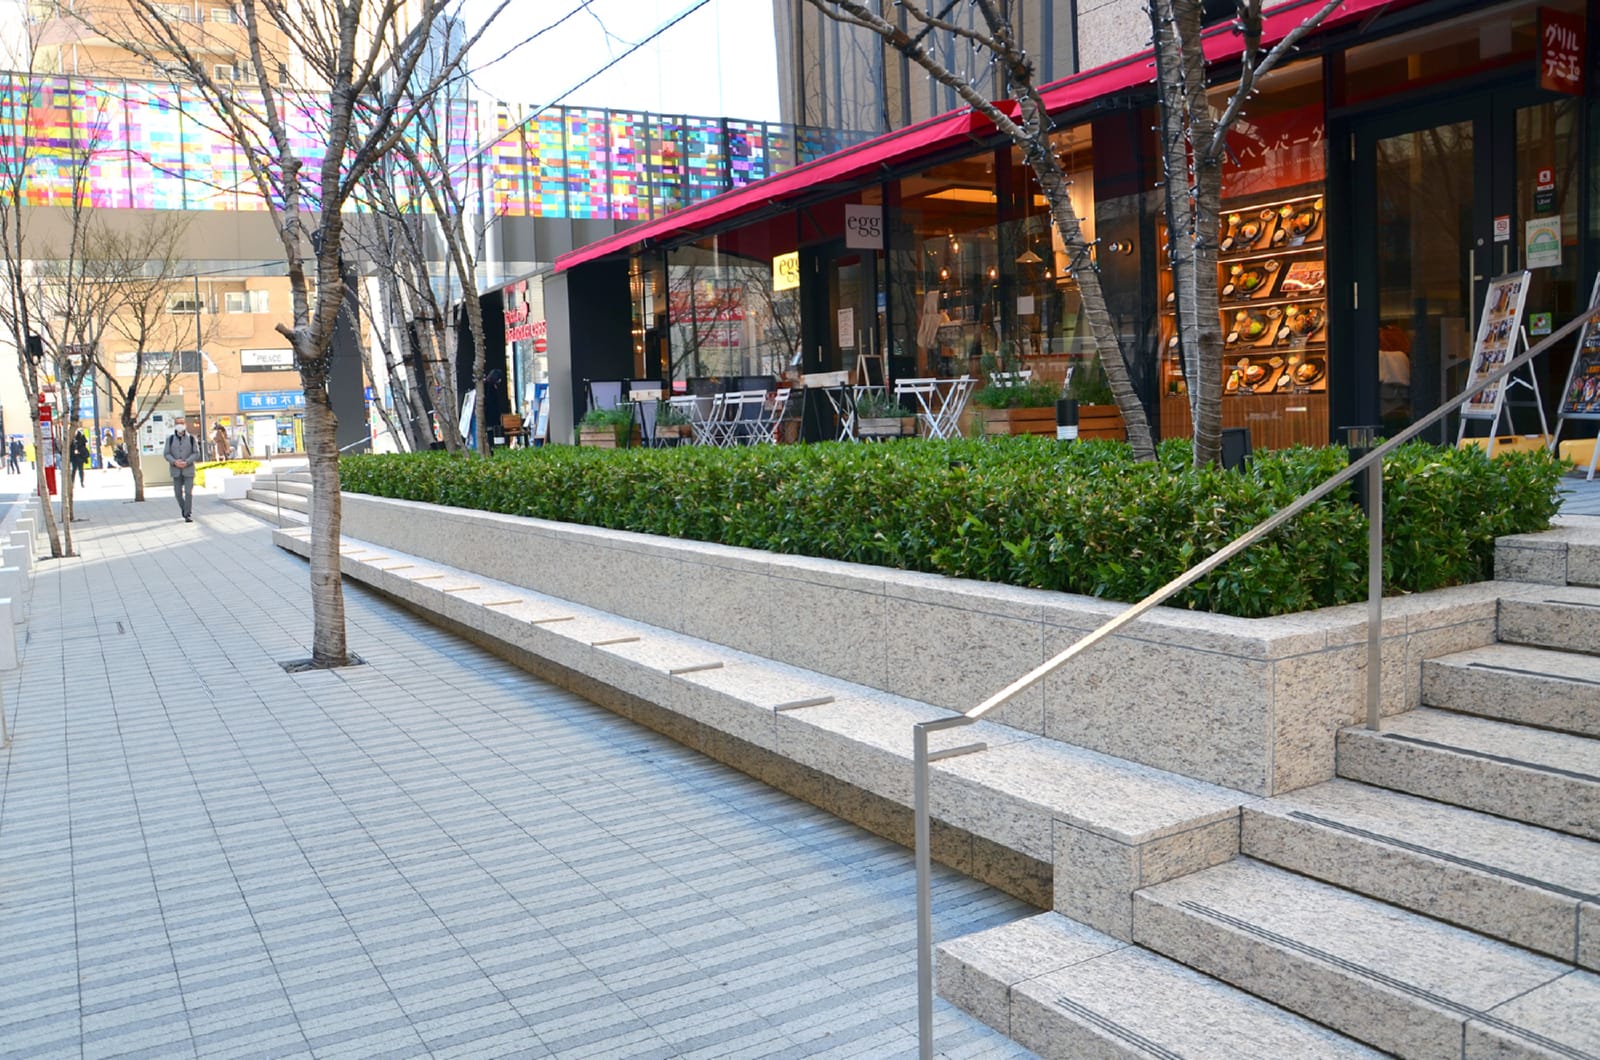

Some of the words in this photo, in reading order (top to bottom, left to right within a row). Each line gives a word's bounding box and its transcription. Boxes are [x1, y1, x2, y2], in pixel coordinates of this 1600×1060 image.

[1545, 24, 1580, 51] グリル
[1545, 50, 1581, 81] デミ玉
[847, 216, 881, 237] egg
[779, 258, 799, 283] eg
